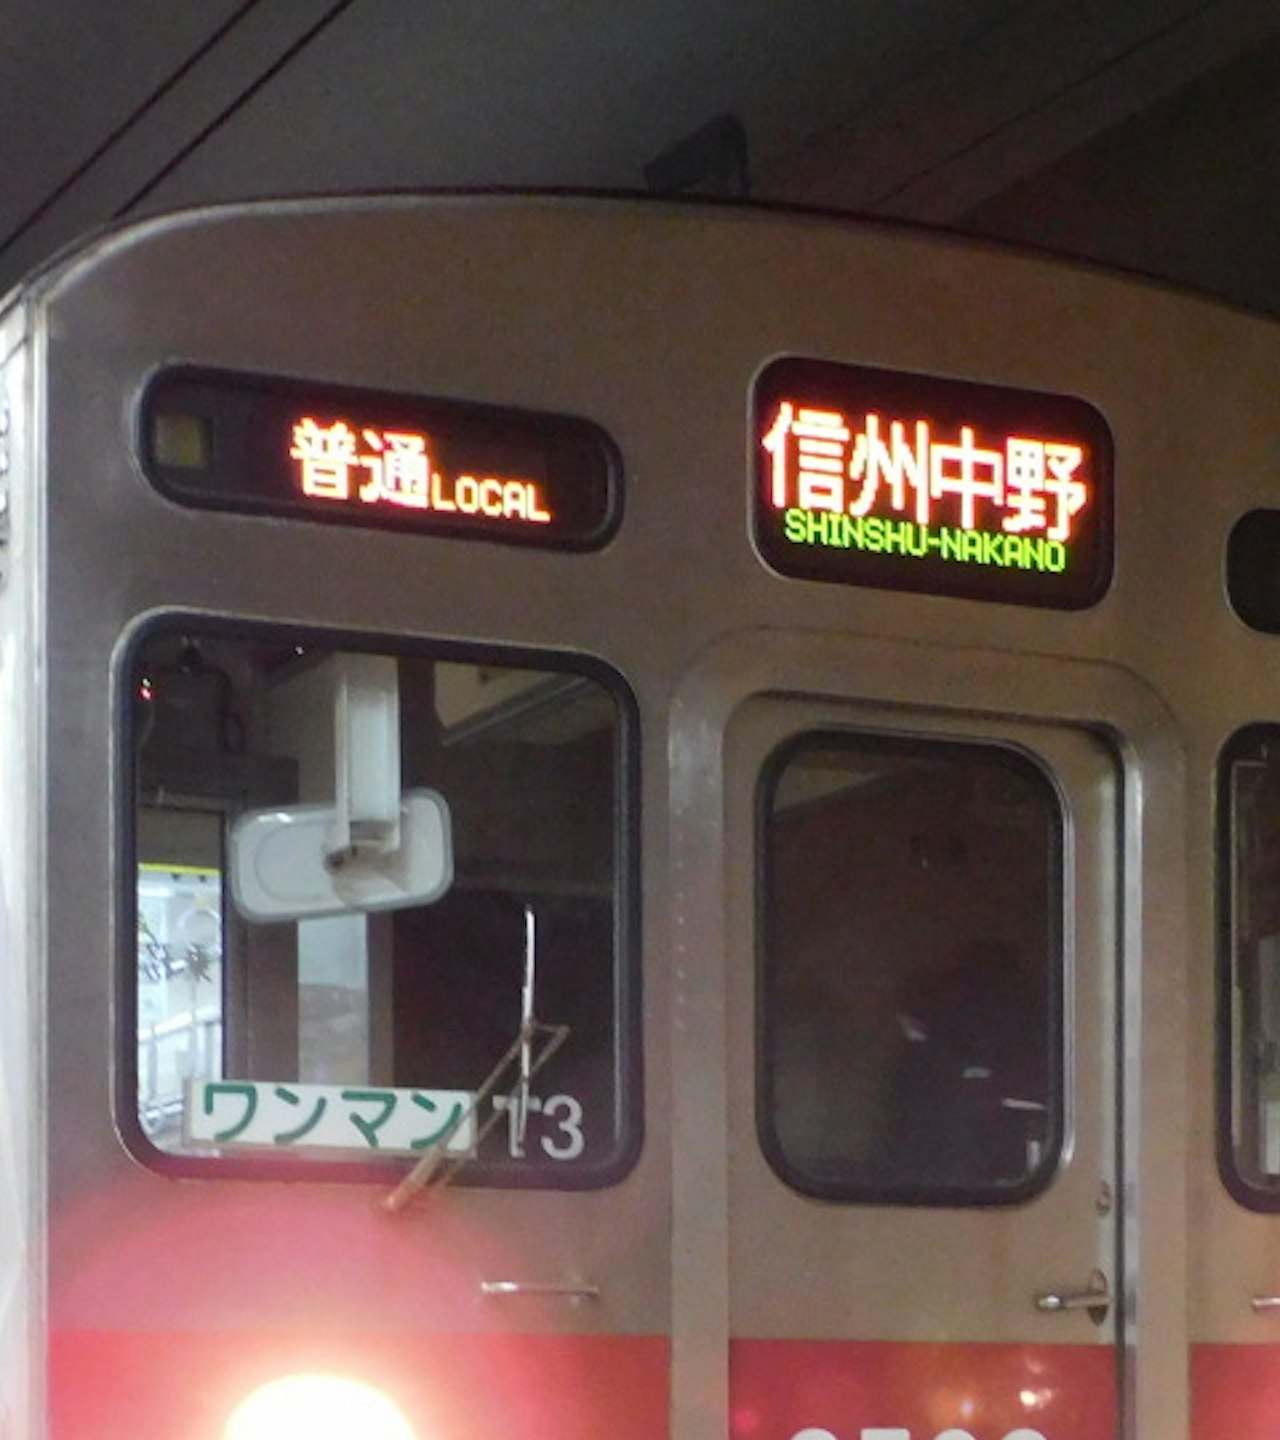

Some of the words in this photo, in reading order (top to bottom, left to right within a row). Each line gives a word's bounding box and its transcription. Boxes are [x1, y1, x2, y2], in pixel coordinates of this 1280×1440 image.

[290, 417, 429, 508] 普通
[431, 471, 551, 522] LOCAL
[762, 401, 1087, 542] 信州中野
[784, 508, 1066, 573] SHINSHU-NAKANO
[204, 1083, 463, 1149] ワンマン
